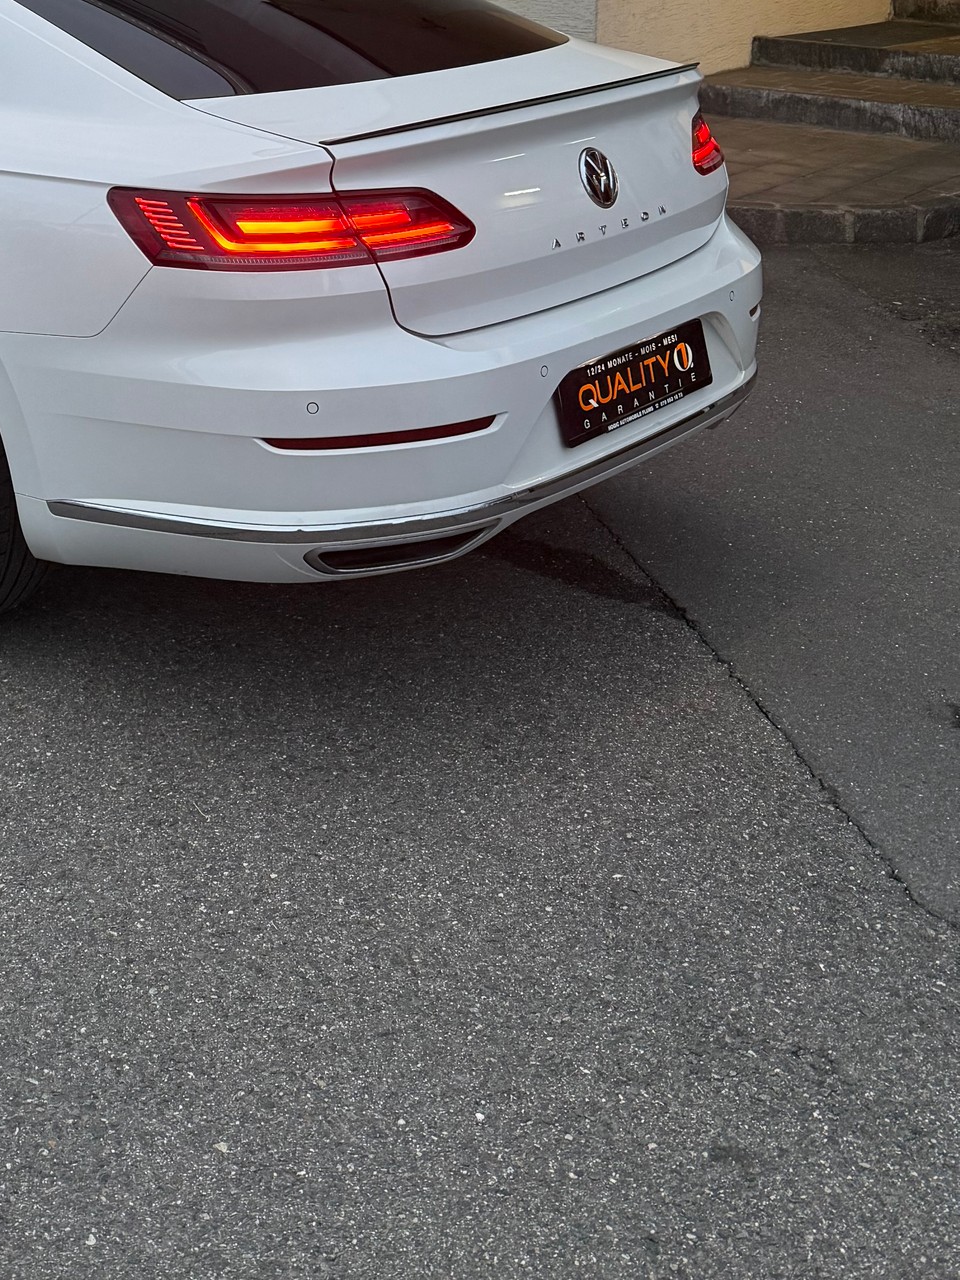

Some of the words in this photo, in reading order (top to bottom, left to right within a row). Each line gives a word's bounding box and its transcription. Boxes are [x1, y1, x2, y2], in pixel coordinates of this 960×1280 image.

[551, 205, 667, 250] ARTEON
[587, 364, 606, 377] 12/24
[607, 352, 634, 369] MONATE
[640, 343, 657, 355] MOIS
[662, 333, 678, 346] MESI
[583, 372, 697, 429] GARANTIE
